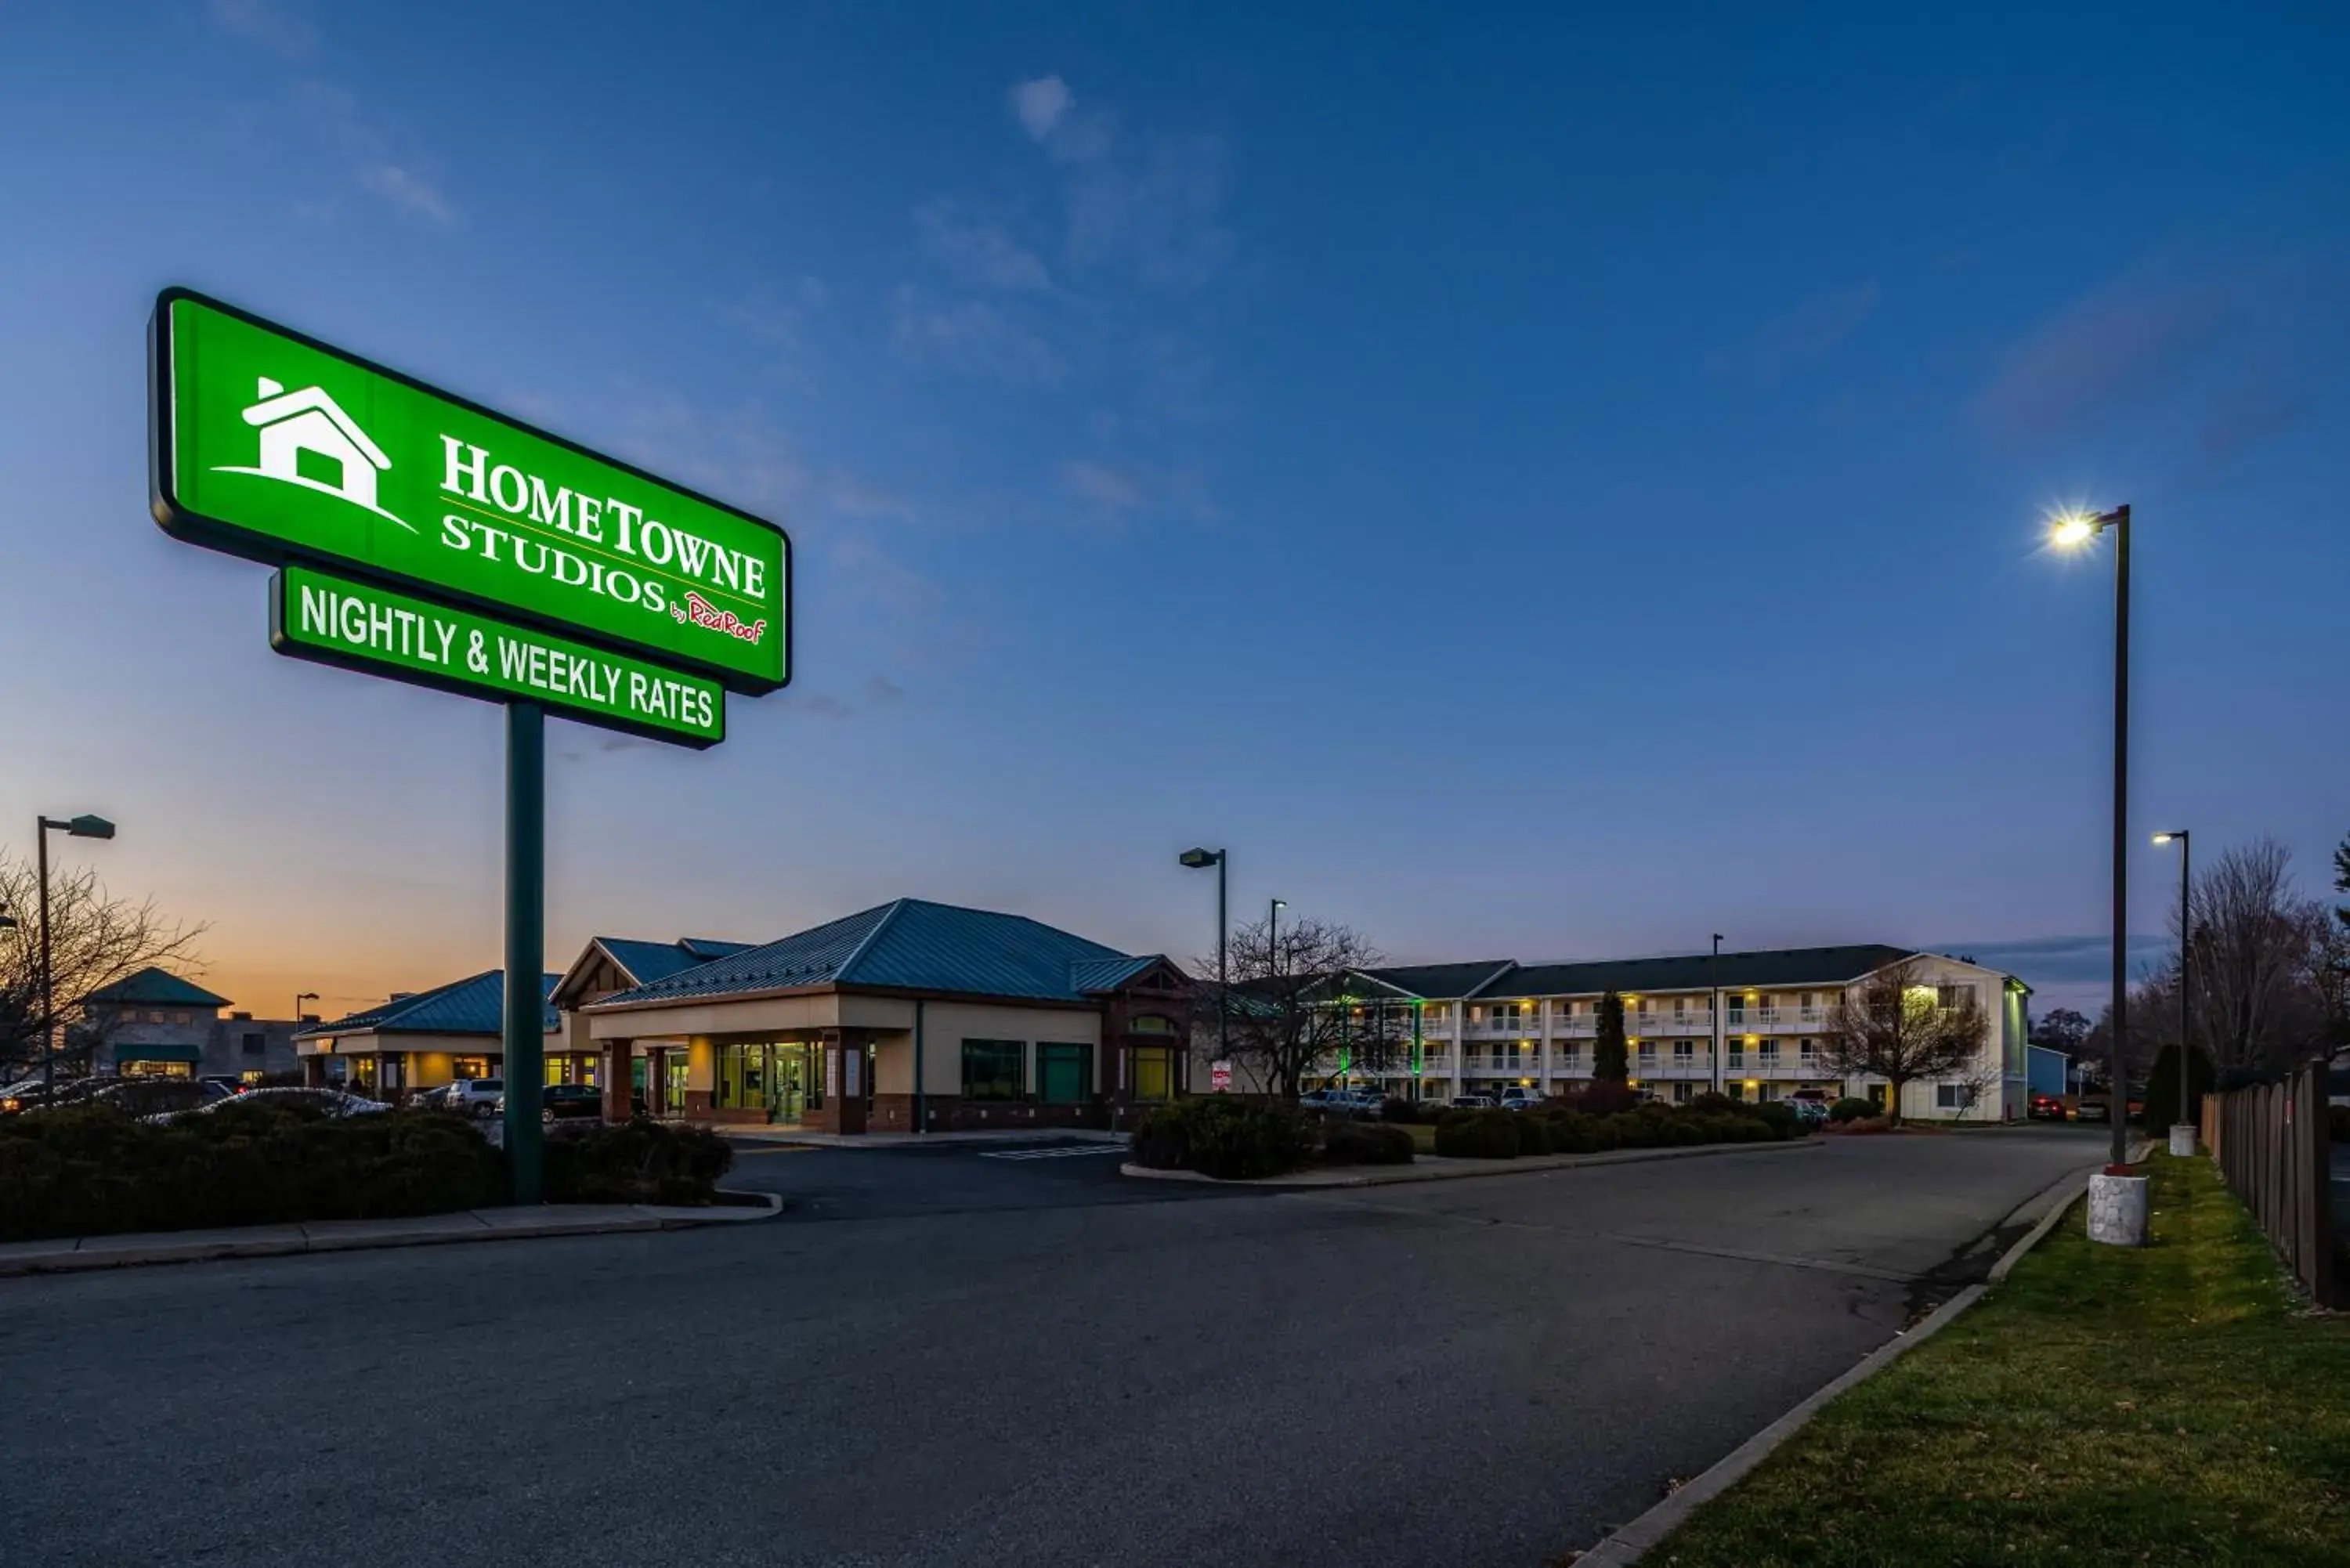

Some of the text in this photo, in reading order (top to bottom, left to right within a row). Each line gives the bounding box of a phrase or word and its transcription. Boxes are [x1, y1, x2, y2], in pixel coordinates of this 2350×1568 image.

[439, 433, 765, 599] HOMETOWNE
[441, 515, 665, 612] STUDIOS
[301, 584, 714, 728] NIGHTLY & WEEKLY RATES
[671, 602, 686, 623] by
